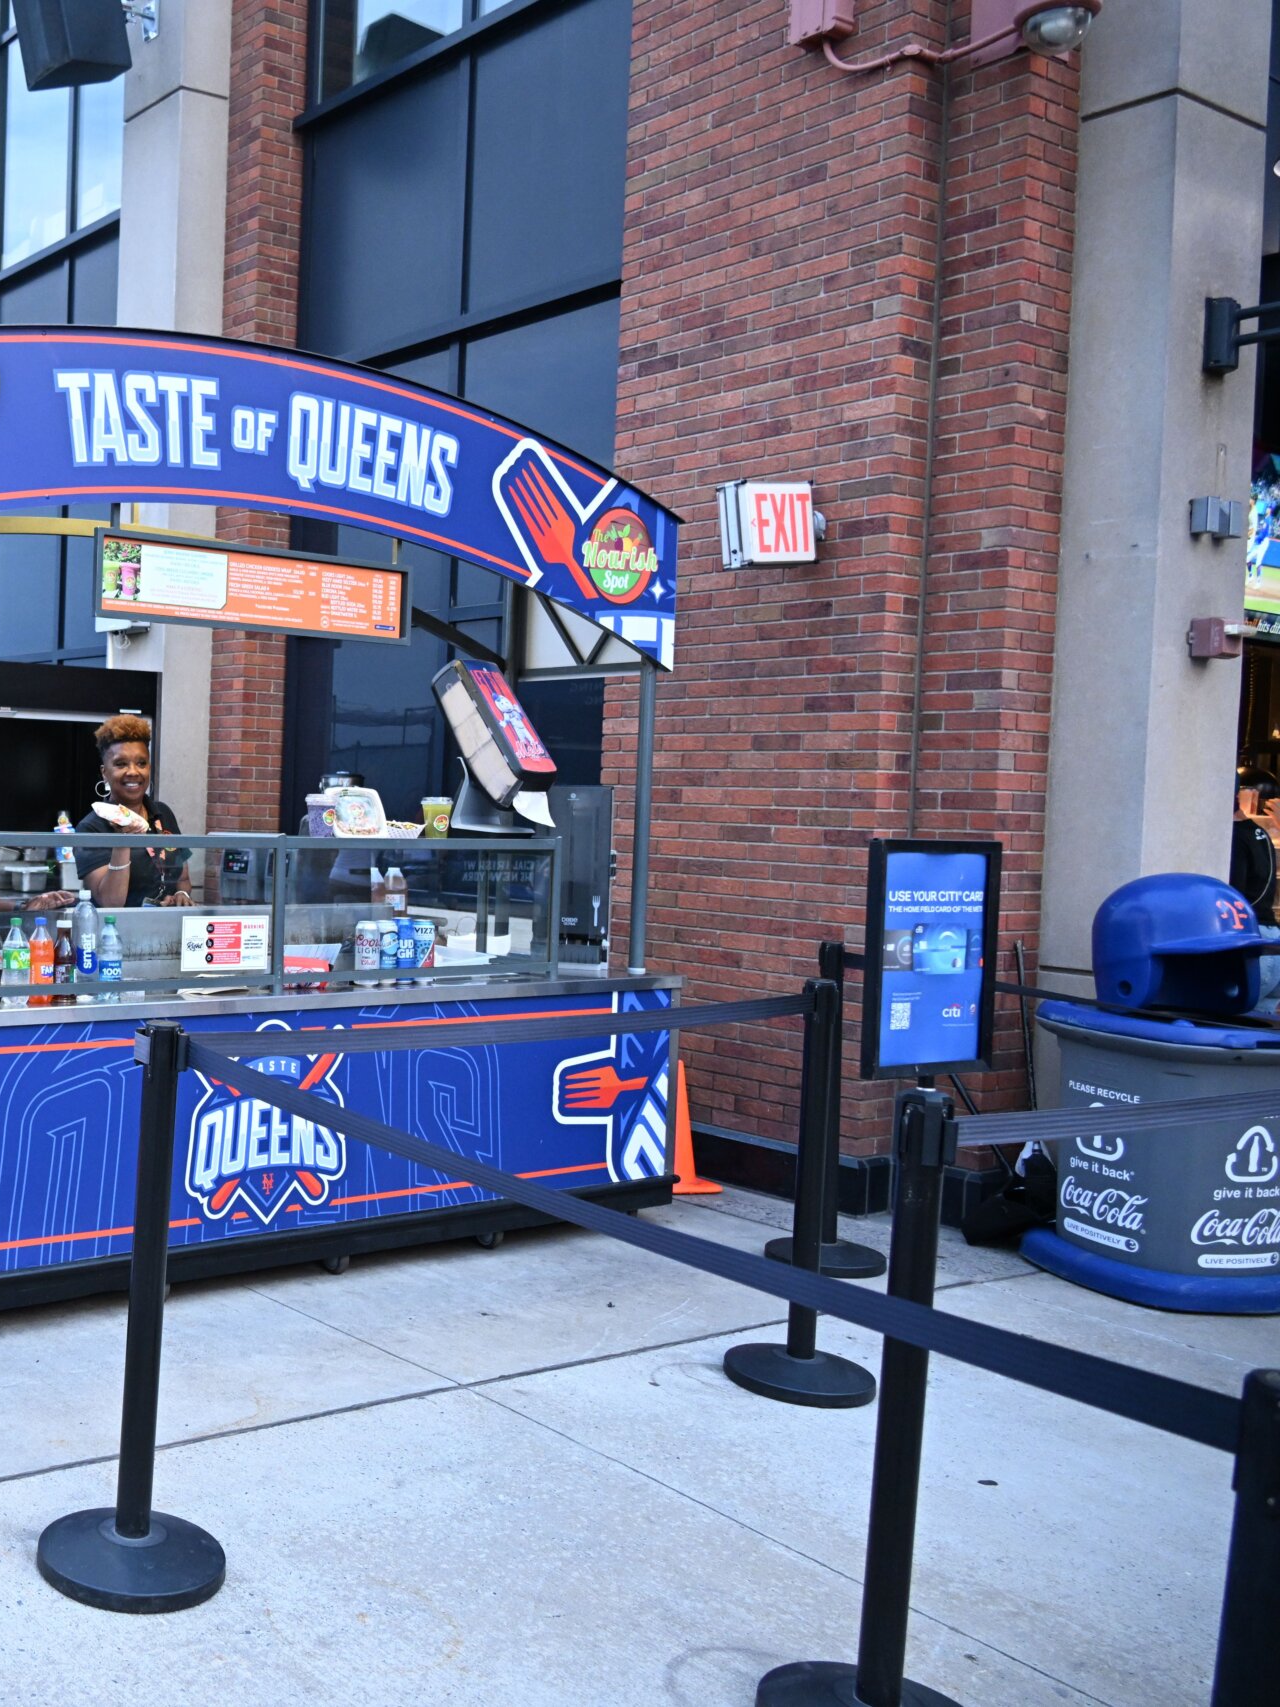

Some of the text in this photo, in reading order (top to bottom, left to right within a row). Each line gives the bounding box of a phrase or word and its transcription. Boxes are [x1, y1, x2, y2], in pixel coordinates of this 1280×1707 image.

[55, 369, 459, 517] TASTE OF QUEENS
[755, 493, 810, 553] EXIT
[593, 527, 610, 543] The
[582, 541, 658, 573] Nourish
[603, 570, 629, 590] Spot
[889, 891, 911, 902] USE
[913, 891, 937, 902] YOUR
[962, 891, 984, 902] CARD
[81, 933, 92, 969] smart
[399, 939, 414, 949] UD
[942, 1004, 961, 1018] citi
[248, 1060, 297, 1073] ASTE
[1068, 1080, 1141, 1104] PLEASE RECYCLE
[193, 1098, 339, 1192] QUEENS
[1069, 1156, 1089, 1170] give
[1092, 1161, 1100, 1174] it
[1060, 1175, 1148, 1231] Coca-Cola
[1213, 1187, 1241, 1201] give
[1244, 1186, 1253, 1199] it
[1066, 1221, 1122, 1246] LIVE POSITIVELY
[1204, 1256, 1268, 1265] LIVE POSITIVELY
